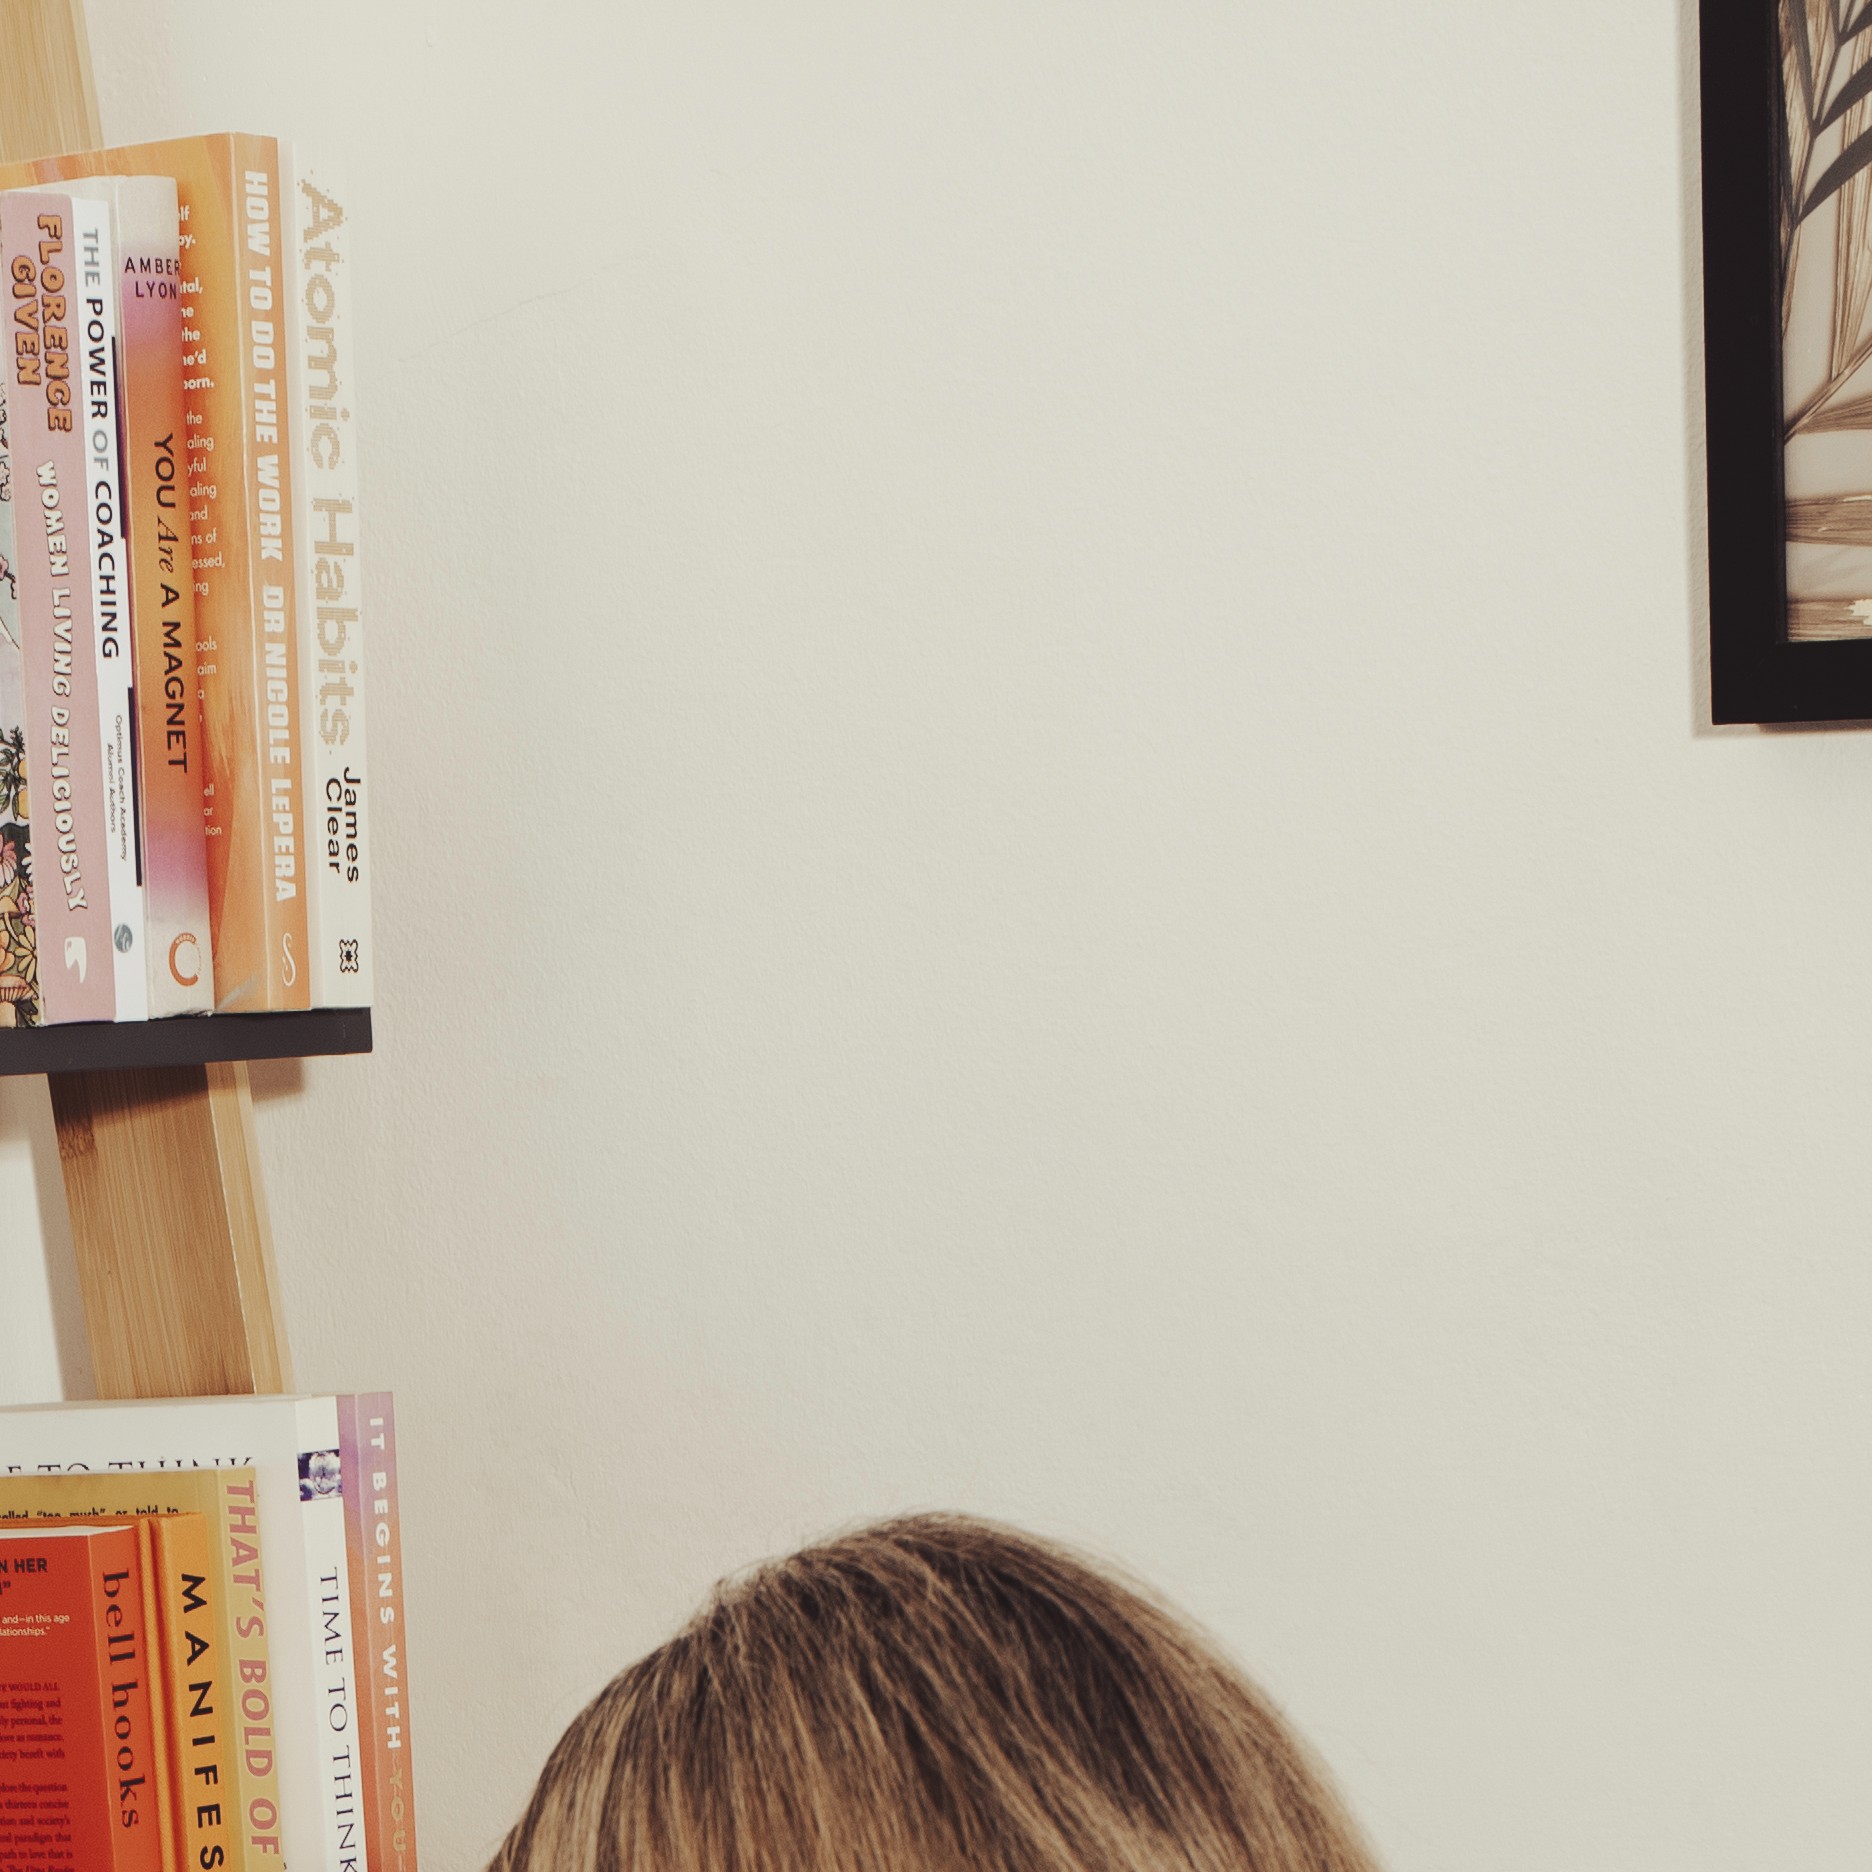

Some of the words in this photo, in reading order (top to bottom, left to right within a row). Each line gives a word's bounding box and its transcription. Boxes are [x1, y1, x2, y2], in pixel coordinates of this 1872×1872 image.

[81, 228, 101, 288] THE
[245, 169, 271, 256] HOW
[124, 256, 181, 276] AMBER
[135, 279, 177, 299] LYON
[249, 266, 272, 311] TO
[11, 255, 41, 387] GIVEN
[37, 213, 73, 433] FLORENCE
[86, 298, 108, 420] POWER
[251, 320, 275, 370] DO
[301, 178, 350, 471] Atomic
[92, 428, 109, 471] OF
[253, 379, 278, 445] THE
[36, 460, 69, 578] WOMEN
[154, 433, 176, 508] YOU
[256, 456, 283, 562] WORK
[94, 479, 120, 660] COACHING
[157, 517, 179, 574] Are
[51, 587, 73, 697] LIVING
[160, 583, 180, 609] A
[263, 584, 286, 634] DR
[312, 497, 359, 746] Habits
[115, 714, 123, 764] Optimus
[162, 620, 188, 774] MAGNET
[264, 642, 291, 765] NICOLE
[51, 705, 89, 913] DELICIOUSLY
[107, 744, 115, 785] Alumni
[117, 766, 125, 803] Coach
[118, 804, 128, 862] Academy
[270, 777, 296, 901] LEPERA
[325, 777, 341, 874] Clear
[343, 766, 361, 884] James
[369, 1417, 385, 1450] IT
[14, 1557, 47, 1574] HER
[226, 1479, 265, 1640] THAT'S
[372, 1471, 394, 1625] BEGINS
[102, 1568, 136, 1665] bell
[319, 1566, 344, 1666] TIME
[238, 1658, 274, 1778] BOLD
[328, 1677, 348, 1733] TO
[381, 1644, 402, 1750] WITH
[112, 1681, 146, 1829] hooks
[248, 1797, 280, 1855] OF
[387, 1772, 407, 1853] YOU
